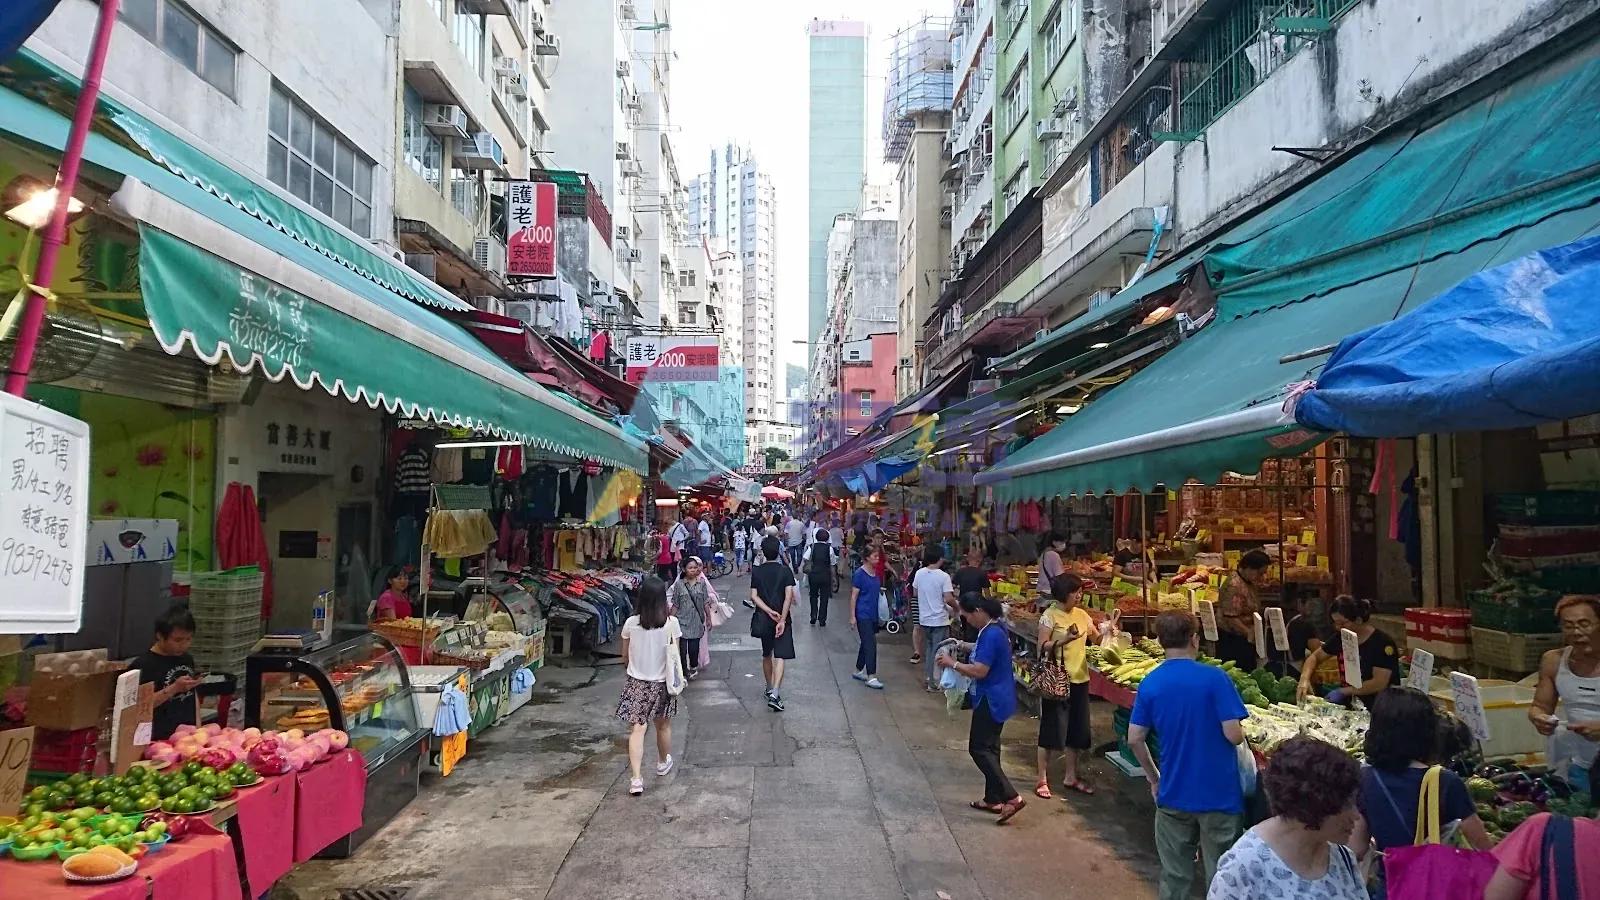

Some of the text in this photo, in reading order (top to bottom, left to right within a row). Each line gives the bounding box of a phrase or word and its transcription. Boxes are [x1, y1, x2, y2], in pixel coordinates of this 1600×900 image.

[512, 185, 532, 224] 護老
[520, 226, 553, 244] 2000
[513, 244, 550, 260] 安老院
[520, 261, 552, 273] 26502031
[629, 343, 717, 368] 護老 2000 安老院
[25, 423, 69, 472] 招聘
[2, 537, 73, 587] 98392473
